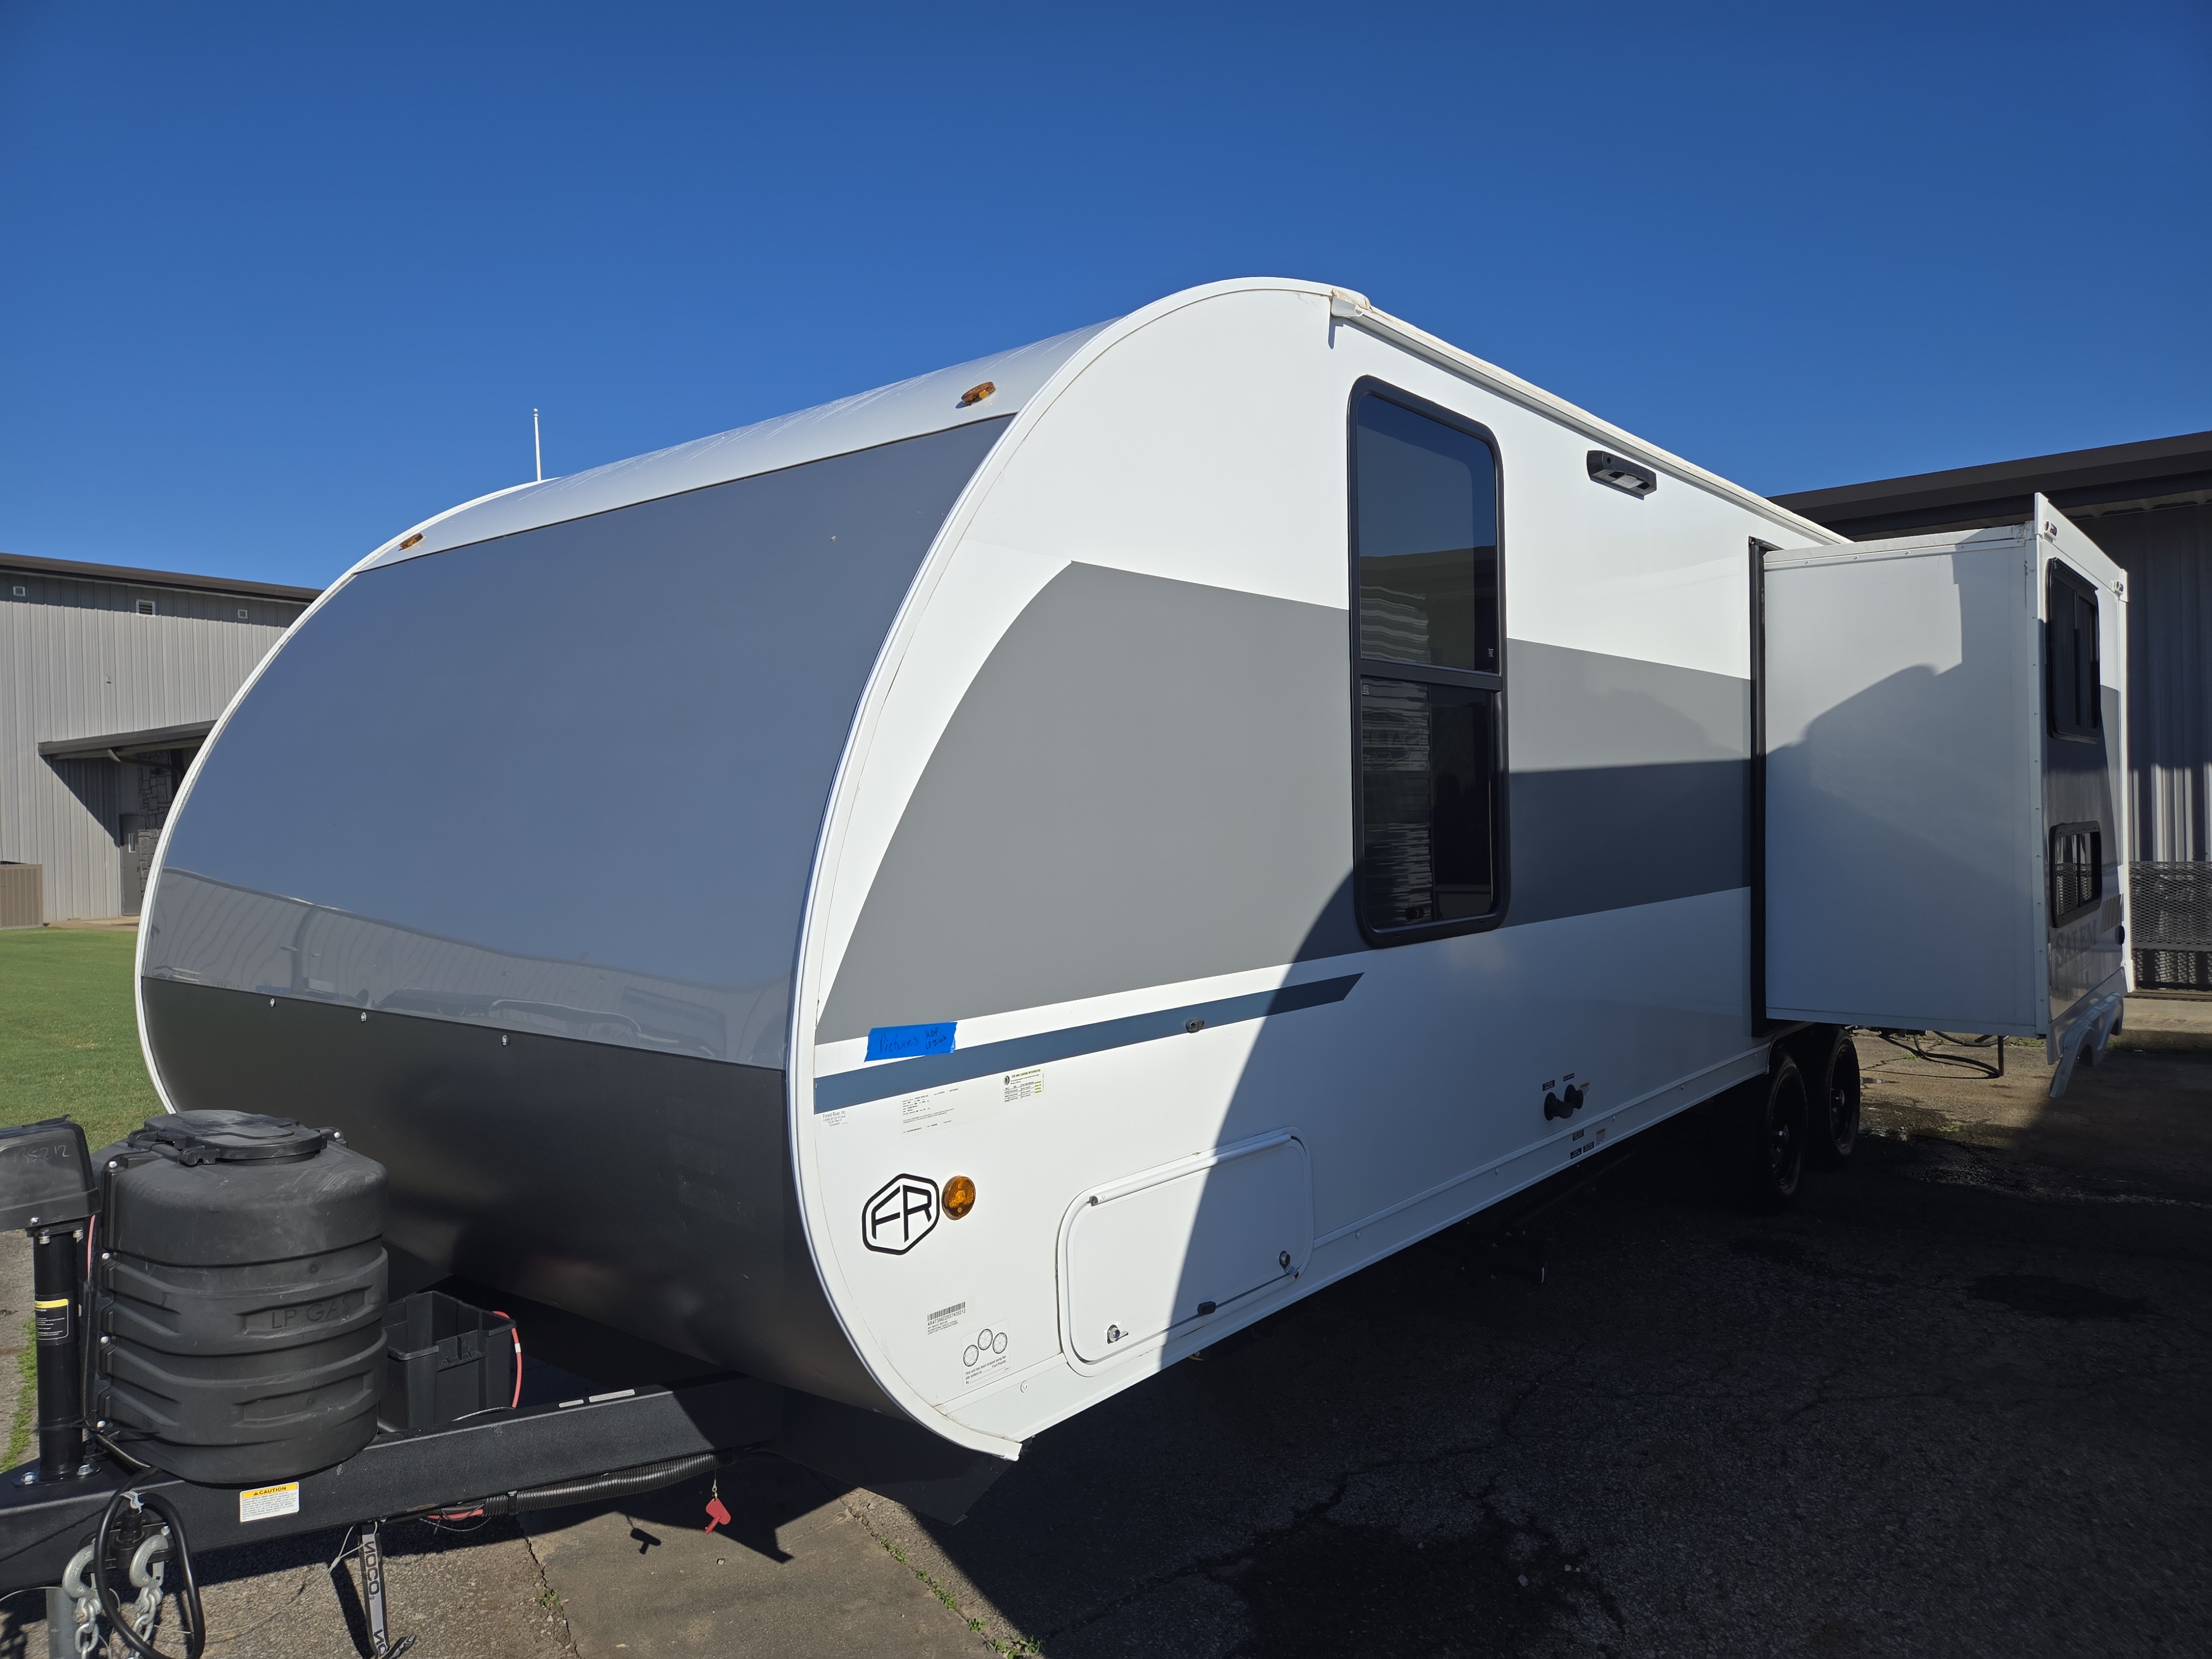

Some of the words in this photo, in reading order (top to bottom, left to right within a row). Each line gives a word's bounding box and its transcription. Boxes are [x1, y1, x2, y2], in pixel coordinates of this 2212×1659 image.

[880, 1033, 919, 1053] Pictures
[871, 1185, 932, 1243] FR
[272, 1309, 298, 1329] LP
[306, 1296, 351, 1322] GAS
[259, 1486, 286, 1495] CAUTION
